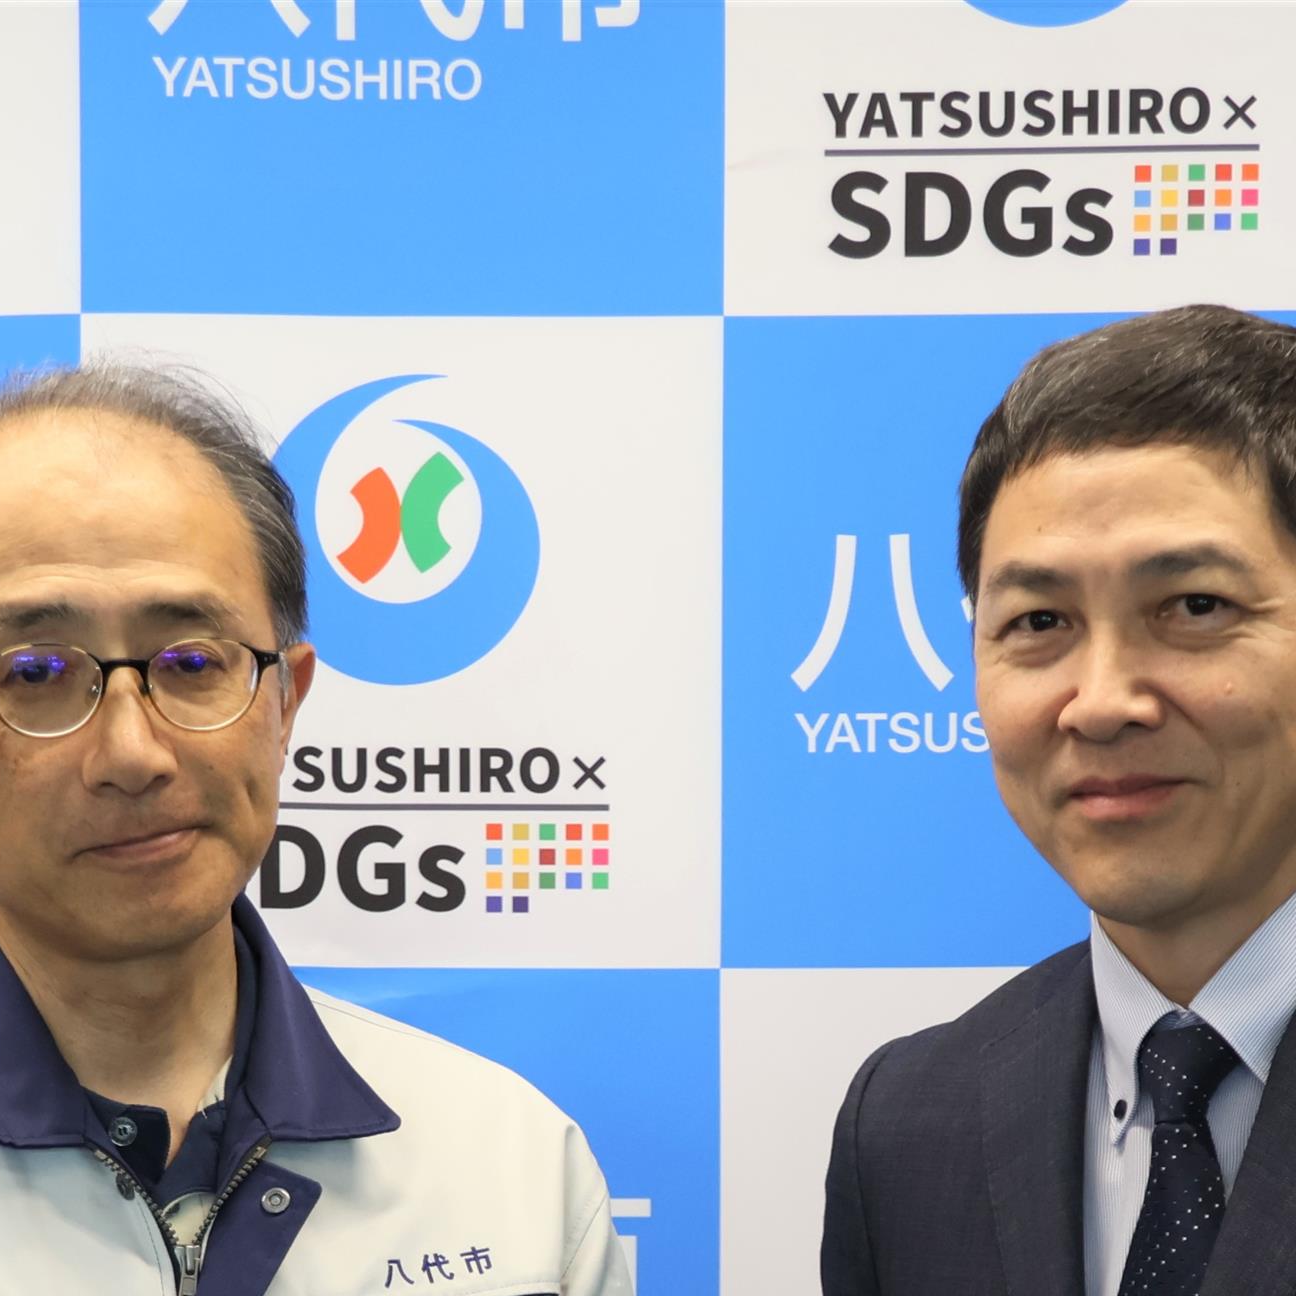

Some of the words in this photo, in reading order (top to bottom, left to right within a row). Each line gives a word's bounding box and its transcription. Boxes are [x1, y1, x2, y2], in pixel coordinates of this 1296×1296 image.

[155, 58, 483, 101] YATSUSHIRO
[830, 170, 1114, 259] SDGs
[795, 711, 990, 753] YATSUS
[285, 746, 606, 794] SUSHIRO×
[259, 824, 466, 912] DGs
[386, 1248, 492, 1288] 八代市
